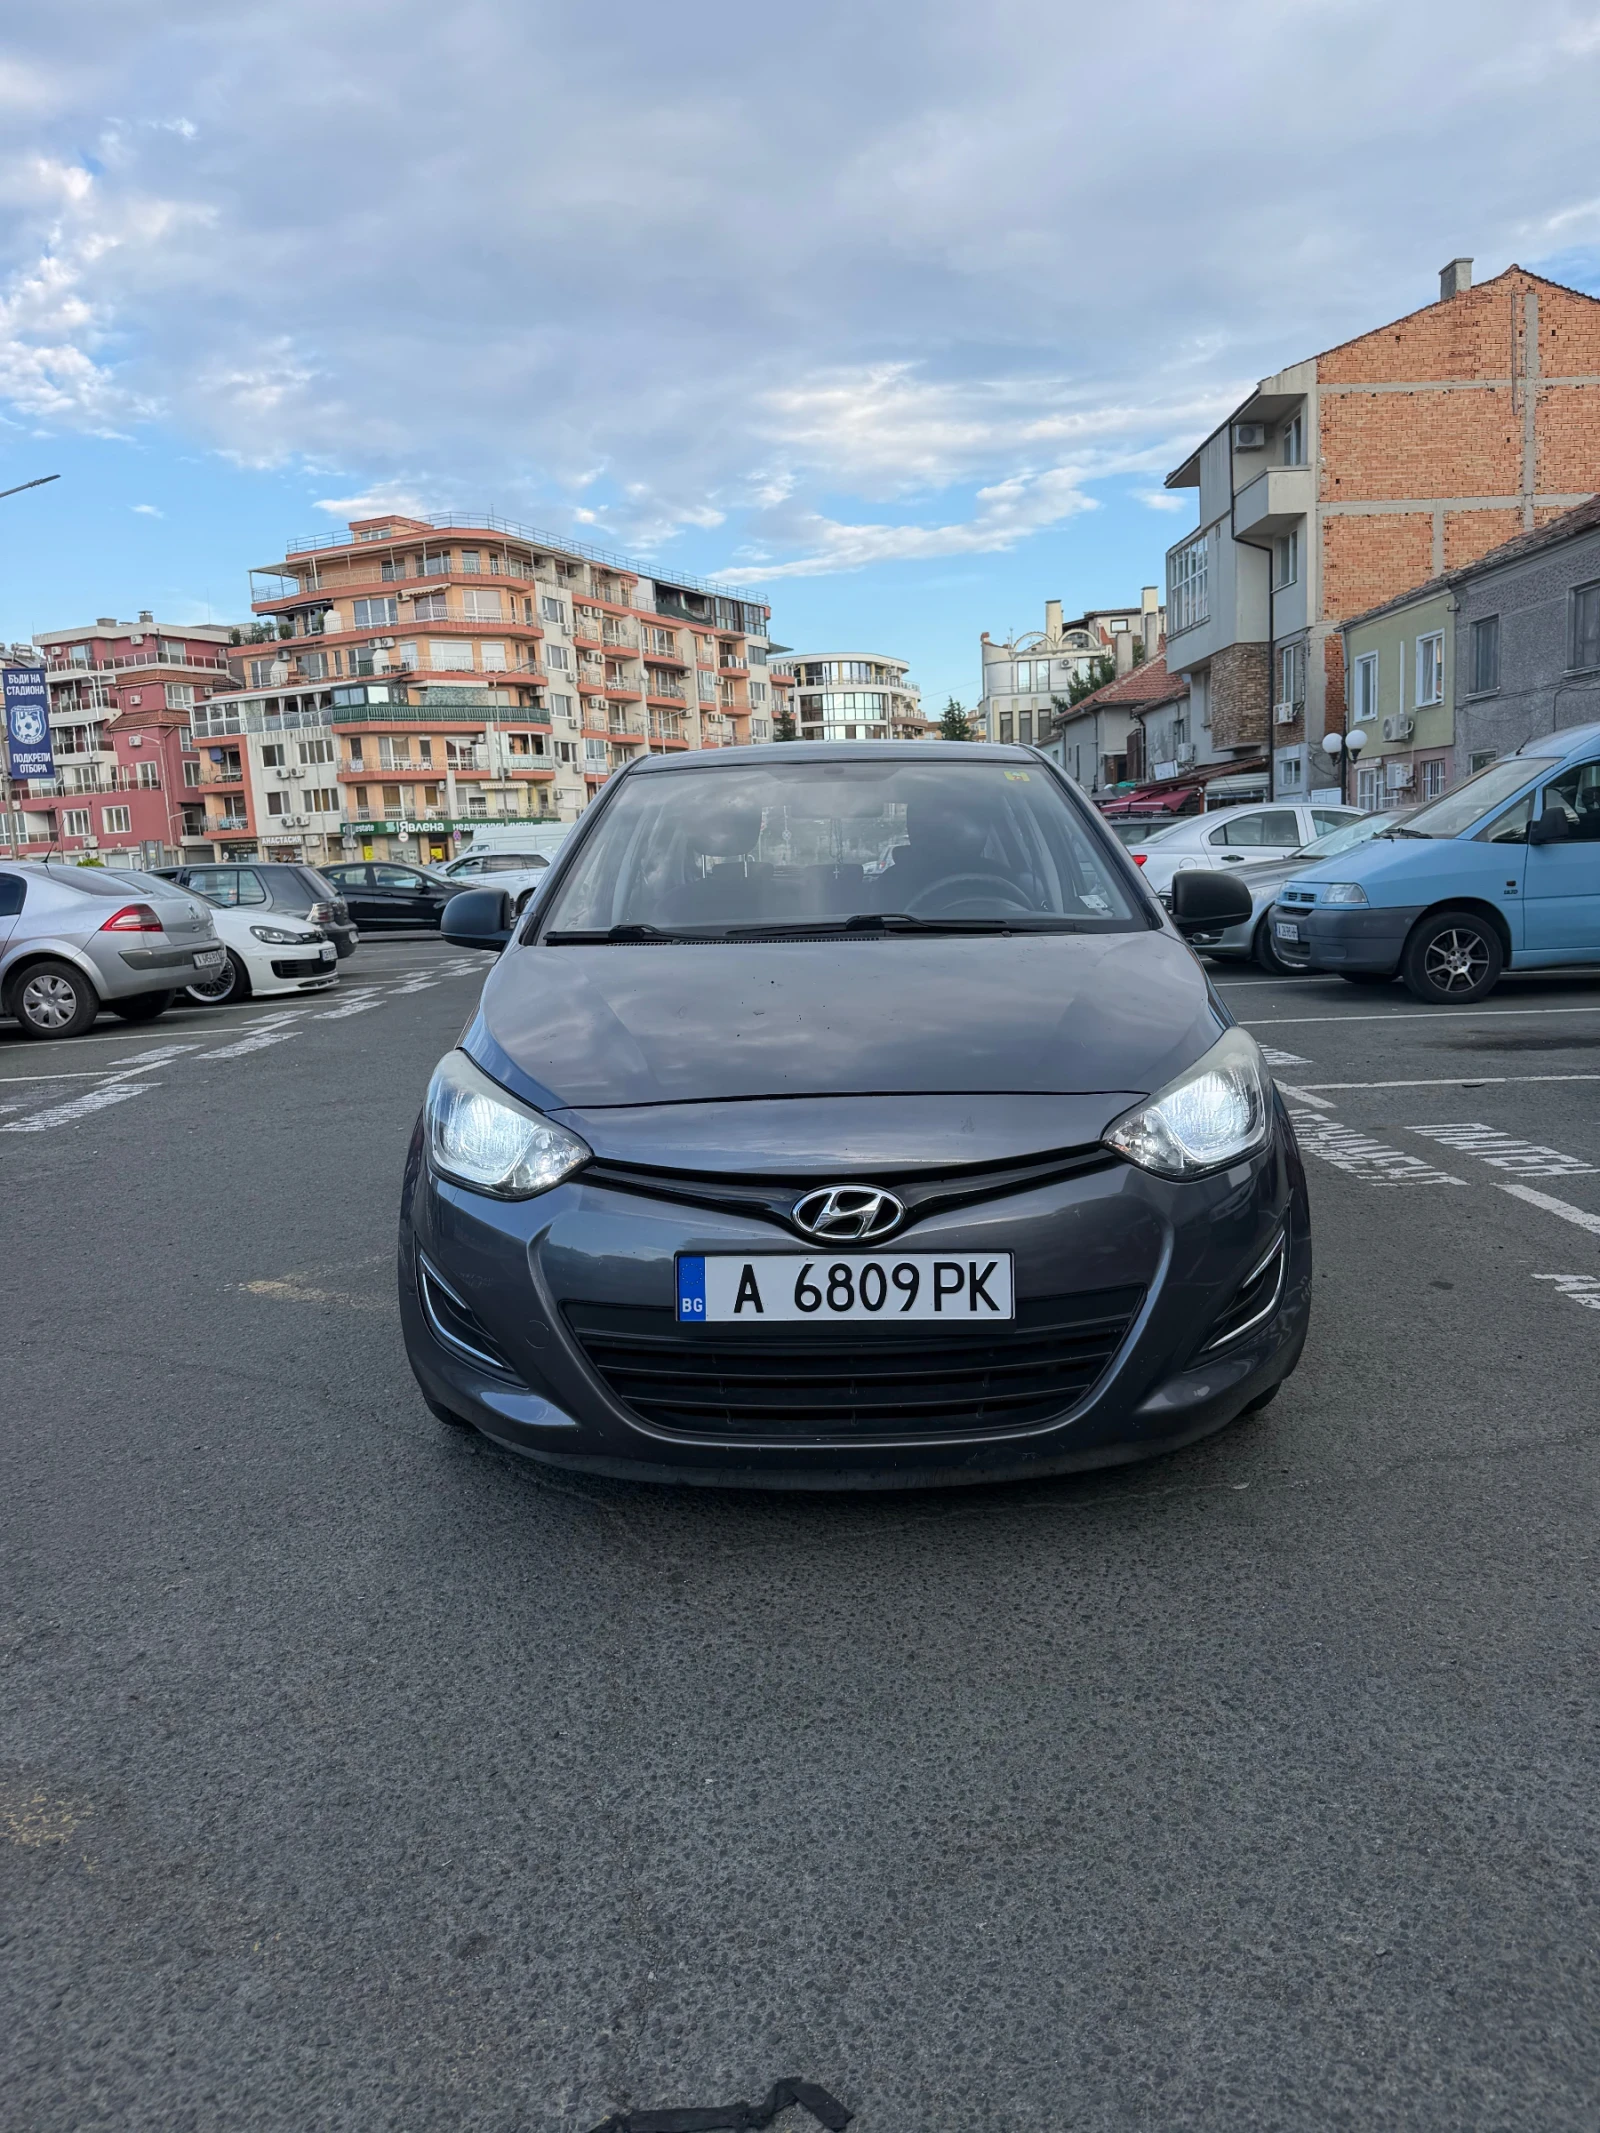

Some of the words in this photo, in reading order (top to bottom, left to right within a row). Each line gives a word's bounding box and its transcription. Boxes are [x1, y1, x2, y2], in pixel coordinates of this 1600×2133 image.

[8, 674, 29, 684] БЪДИ
[30, 674, 41, 683] НА
[6, 685, 45, 696] СТАДИОНА
[13, 752, 51, 763] ПОДКРЕПИ
[20, 764, 47, 774] ОТБОРА
[355, 824, 375, 833] estate
[400, 821, 445, 832] Явлена
[261, 835, 302, 845] АНАСТАСИЯ
[734, 1263, 764, 1314] A
[794, 1262, 920, 1313] 6809
[682, 1297, 703, 1314] BG
